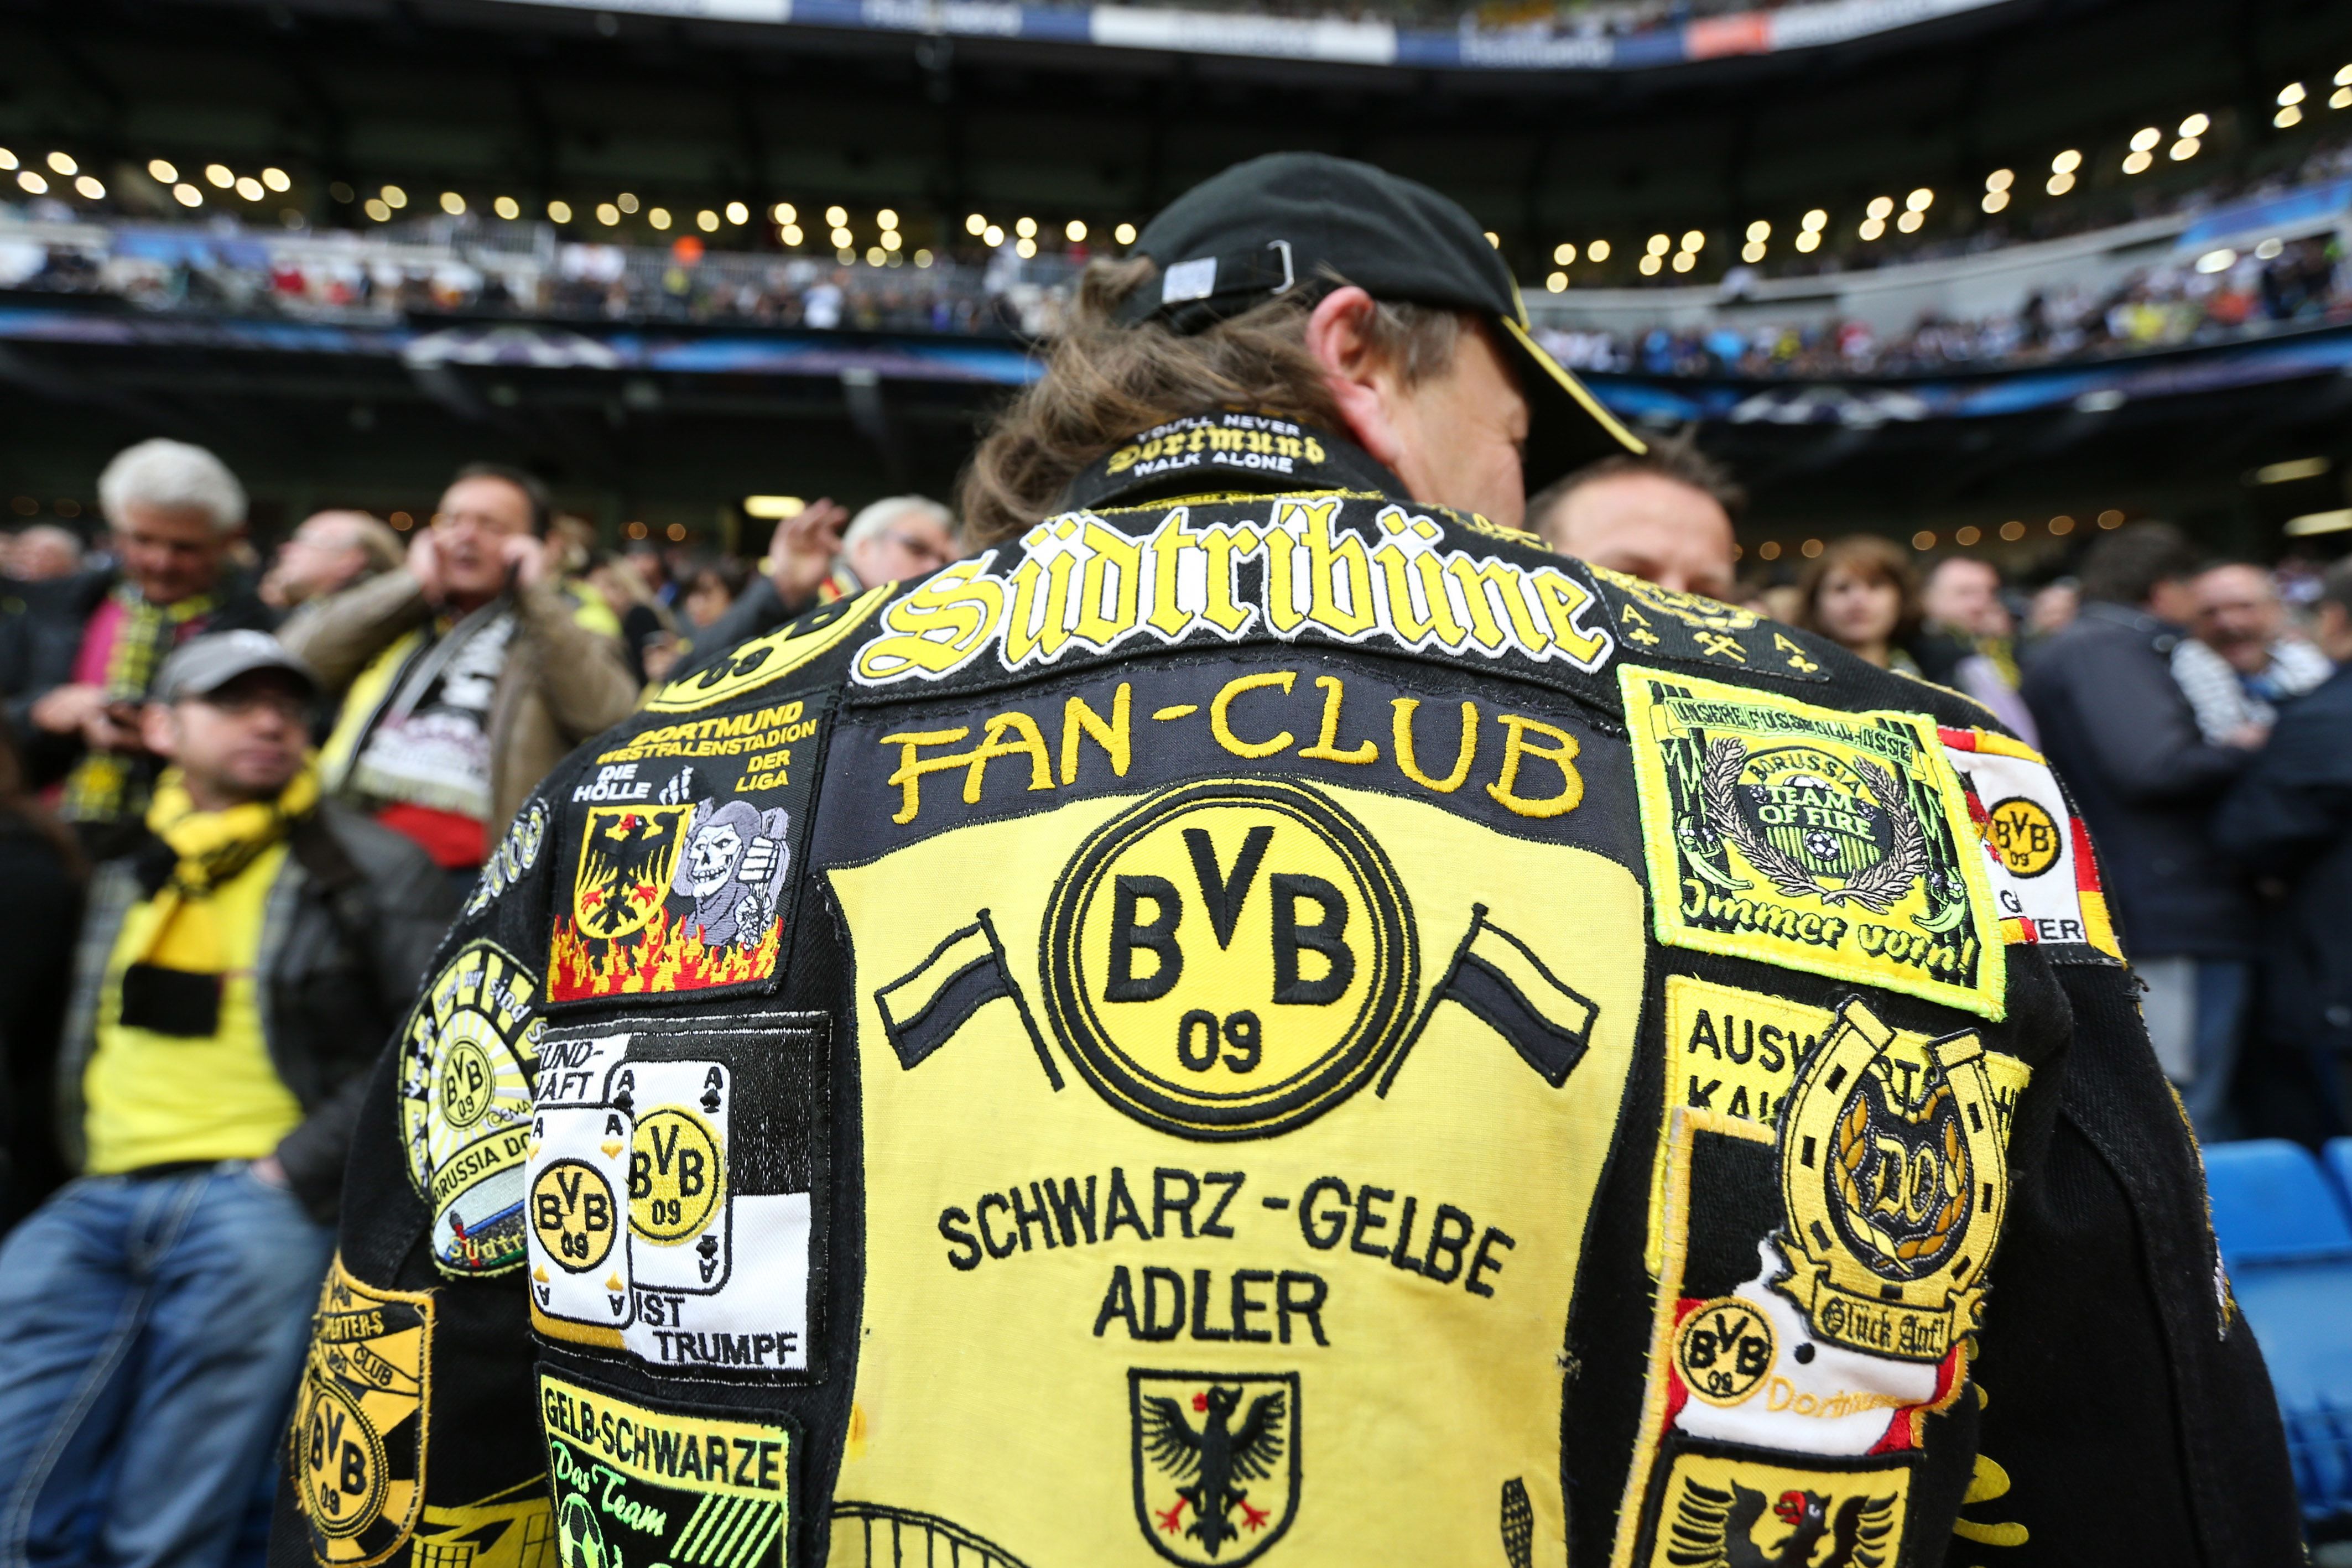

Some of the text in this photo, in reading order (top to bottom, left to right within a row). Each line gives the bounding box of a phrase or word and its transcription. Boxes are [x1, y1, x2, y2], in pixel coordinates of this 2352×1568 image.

[1137, 414, 1300, 443] YOU'LL NEVER
[1134, 451, 1293, 477] WALK ALONE
[851, 497, 1614, 688] Südtribüne
[1621, 603, 1652, 628] A
[1773, 633, 1806, 655] A
[627, 700, 804, 747] DORTMUND
[1671, 700, 1747, 730] UNSERE
[595, 718, 818, 765] WESTFALENSTADION
[881, 670, 1585, 825] FAN-CLUB
[597, 763, 639, 782] DIE
[747, 749, 790, 773] DER
[1748, 753, 1861, 798] BORUSSIA
[573, 780, 652, 803] HÖLLE
[735, 769, 789, 793] LIGA
[1766, 785, 1859, 815] TEAM
[1758, 804, 1876, 842] OF FIRE
[1994, 810, 2052, 852] BVB
[2010, 852, 2030, 866] 09
[1103, 826, 1355, 1006] BVB
[488, 977, 532, 1024] sind
[1177, 1008, 1262, 1073] 09
[446, 1051, 483, 1108] BVB
[617, 1069, 635, 1090] A
[703, 1066, 723, 1088] A
[458, 1095, 475, 1118] 09
[605, 1114, 623, 1135] A
[531, 1117, 544, 1138] A
[433, 1146, 501, 1205] ORUSSIA
[629, 1124, 705, 1200] BVB
[537, 1171, 610, 1232] BVB
[652, 1199, 681, 1225] 09
[560, 1234, 589, 1259] 09
[636, 1291, 685, 1327] IST
[1093, 1264, 1330, 1347] ADLER
[653, 1330, 798, 1366] TRUMPF
[1689, 1313, 1767, 1376] BVB
[353, 1347, 393, 1386] CLUB
[310, 1400, 368, 1496] BVB
[544, 1387, 782, 1491] GELB-SCHWARZE
[552, 1441, 667, 1536] Das Team
